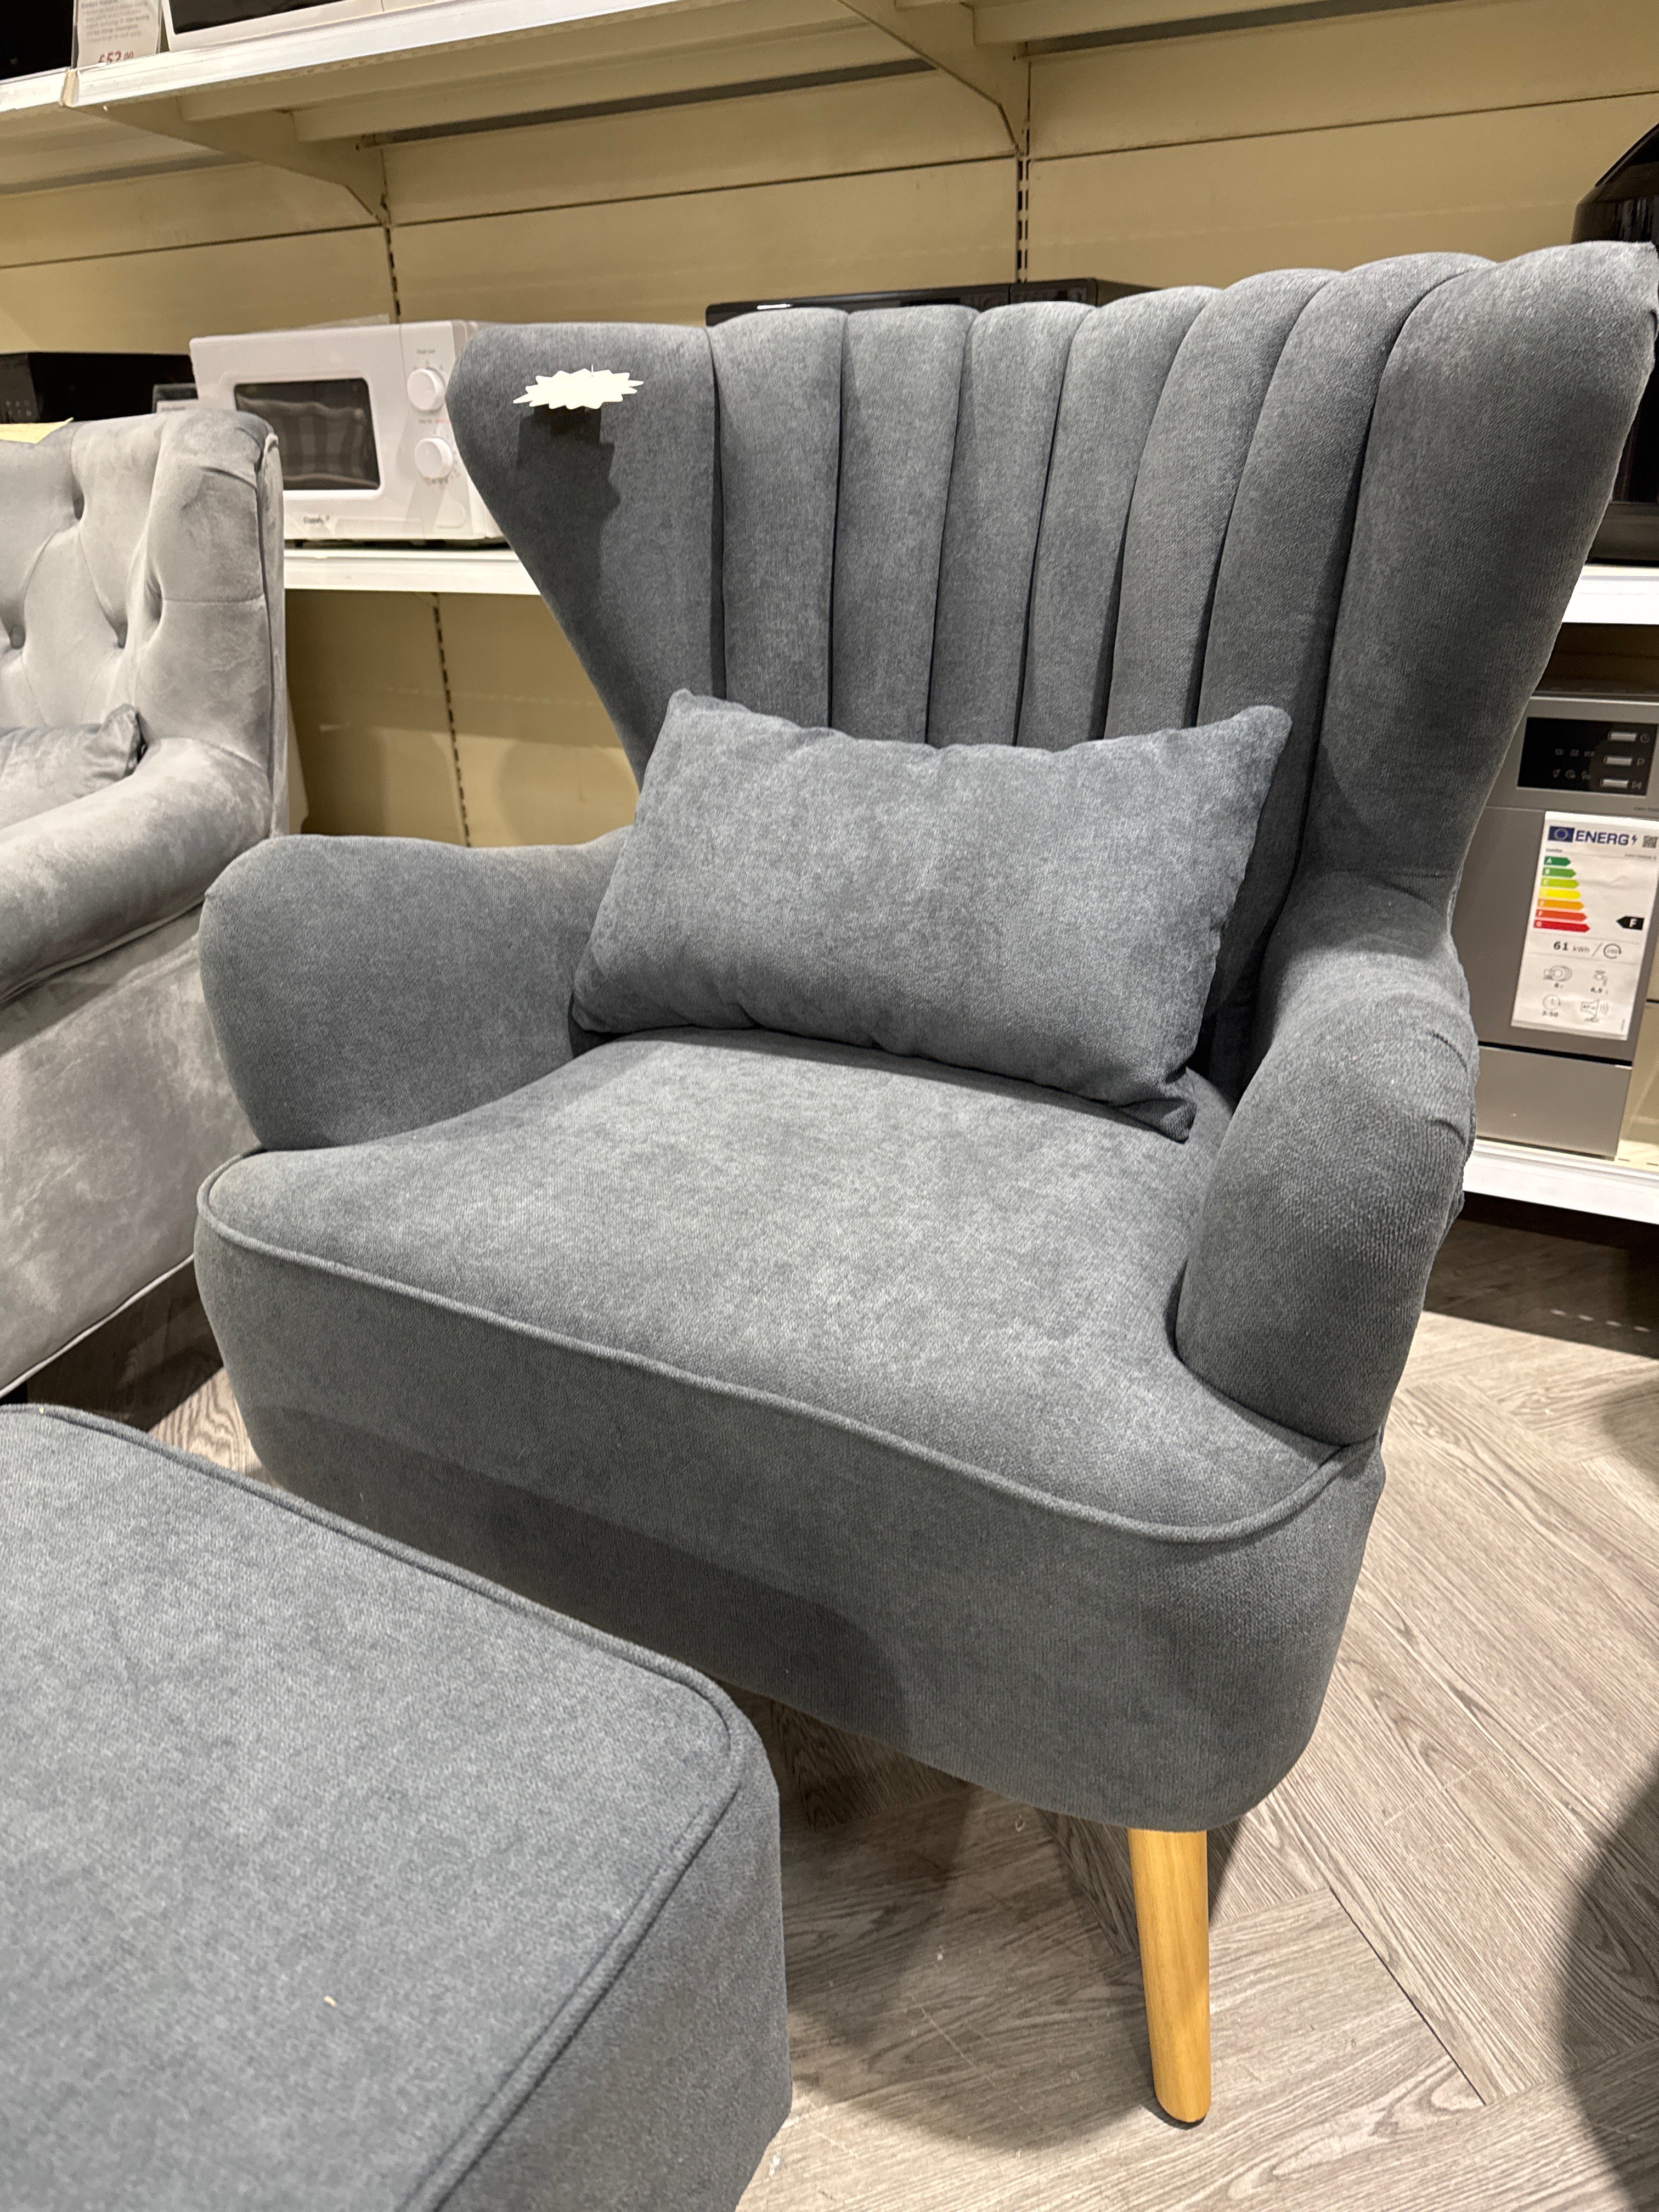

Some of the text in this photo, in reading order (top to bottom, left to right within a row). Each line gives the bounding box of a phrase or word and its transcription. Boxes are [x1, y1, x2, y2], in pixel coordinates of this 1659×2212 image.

[1575, 831, 1629, 845] ENERG
[1629, 918, 1637, 928] F
[1554, 941, 1568, 951] 61
